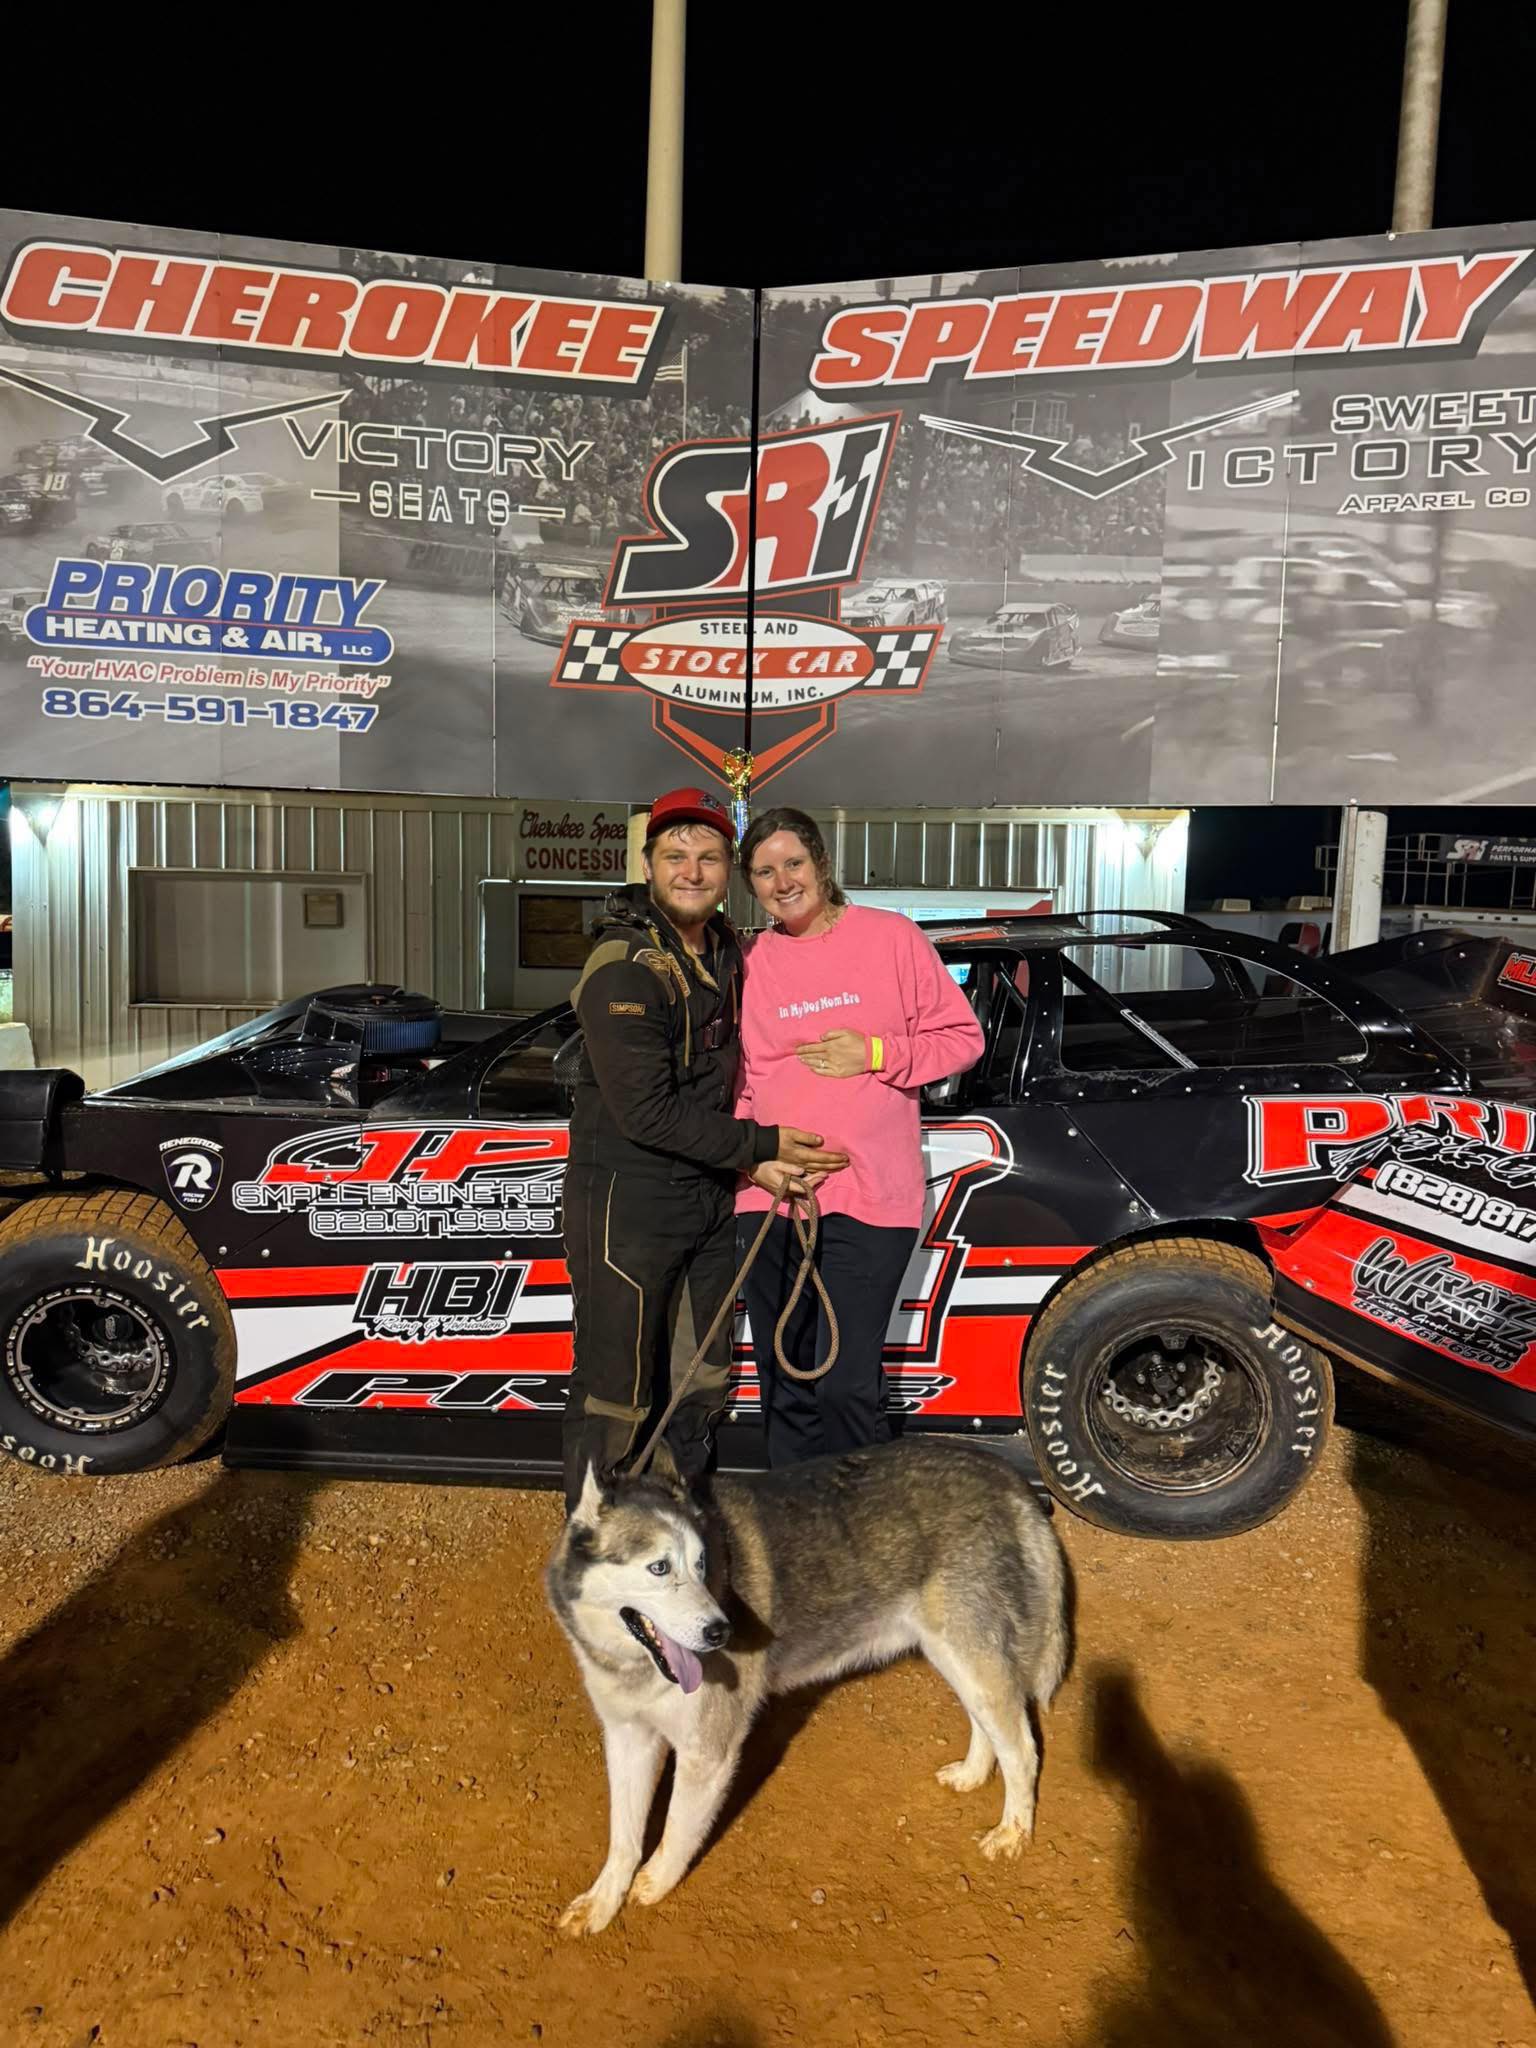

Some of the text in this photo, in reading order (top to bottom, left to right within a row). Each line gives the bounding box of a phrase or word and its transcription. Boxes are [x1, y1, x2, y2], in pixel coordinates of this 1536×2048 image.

[2, 241, 666, 385] CHEROKEE
[809, 247, 1535, 391] SPEEDWAY
[1331, 386, 1536, 434] SWEET
[282, 416, 595, 481] VICTORY
[369, 480, 510, 526] SEATS
[614, 421, 890, 600] SRI
[1336, 490, 1475, 515] APPAREL
[47, 557, 386, 626] PRIORITY
[46, 616, 373, 657] HEATING & AIR, LLC
[700, 622, 798, 636] STEEL AND
[94, 659, 155, 682] HVAC
[159, 665, 243, 688] Problem
[247, 671, 266, 688] is
[271, 673, 301, 694] My
[639, 647, 858, 675] STOCK CAR
[42, 688, 380, 733] 864-591-1847
[671, 683, 824, 705] ALUMINUM, INC.
[519, 809, 628, 846] Cherokee Spee
[611, 1004, 643, 1014] SIMPSON
[779, 992, 860, 1018] In My Dog Mom Era
[159, 1137, 224, 1151] RENEGADE
[168, 1153, 213, 1190] R
[234, 1181, 364, 1207] SMALL
[367, 1181, 496, 1206] ENGINE
[75, 1236, 210, 1329] Hoosier
[359, 1263, 529, 1319] HBI
[373, 1313, 423, 1336] Racing
[1252, 1322, 1325, 1459] Hoosier
[1032, 1362, 1106, 1502] Hoosier
